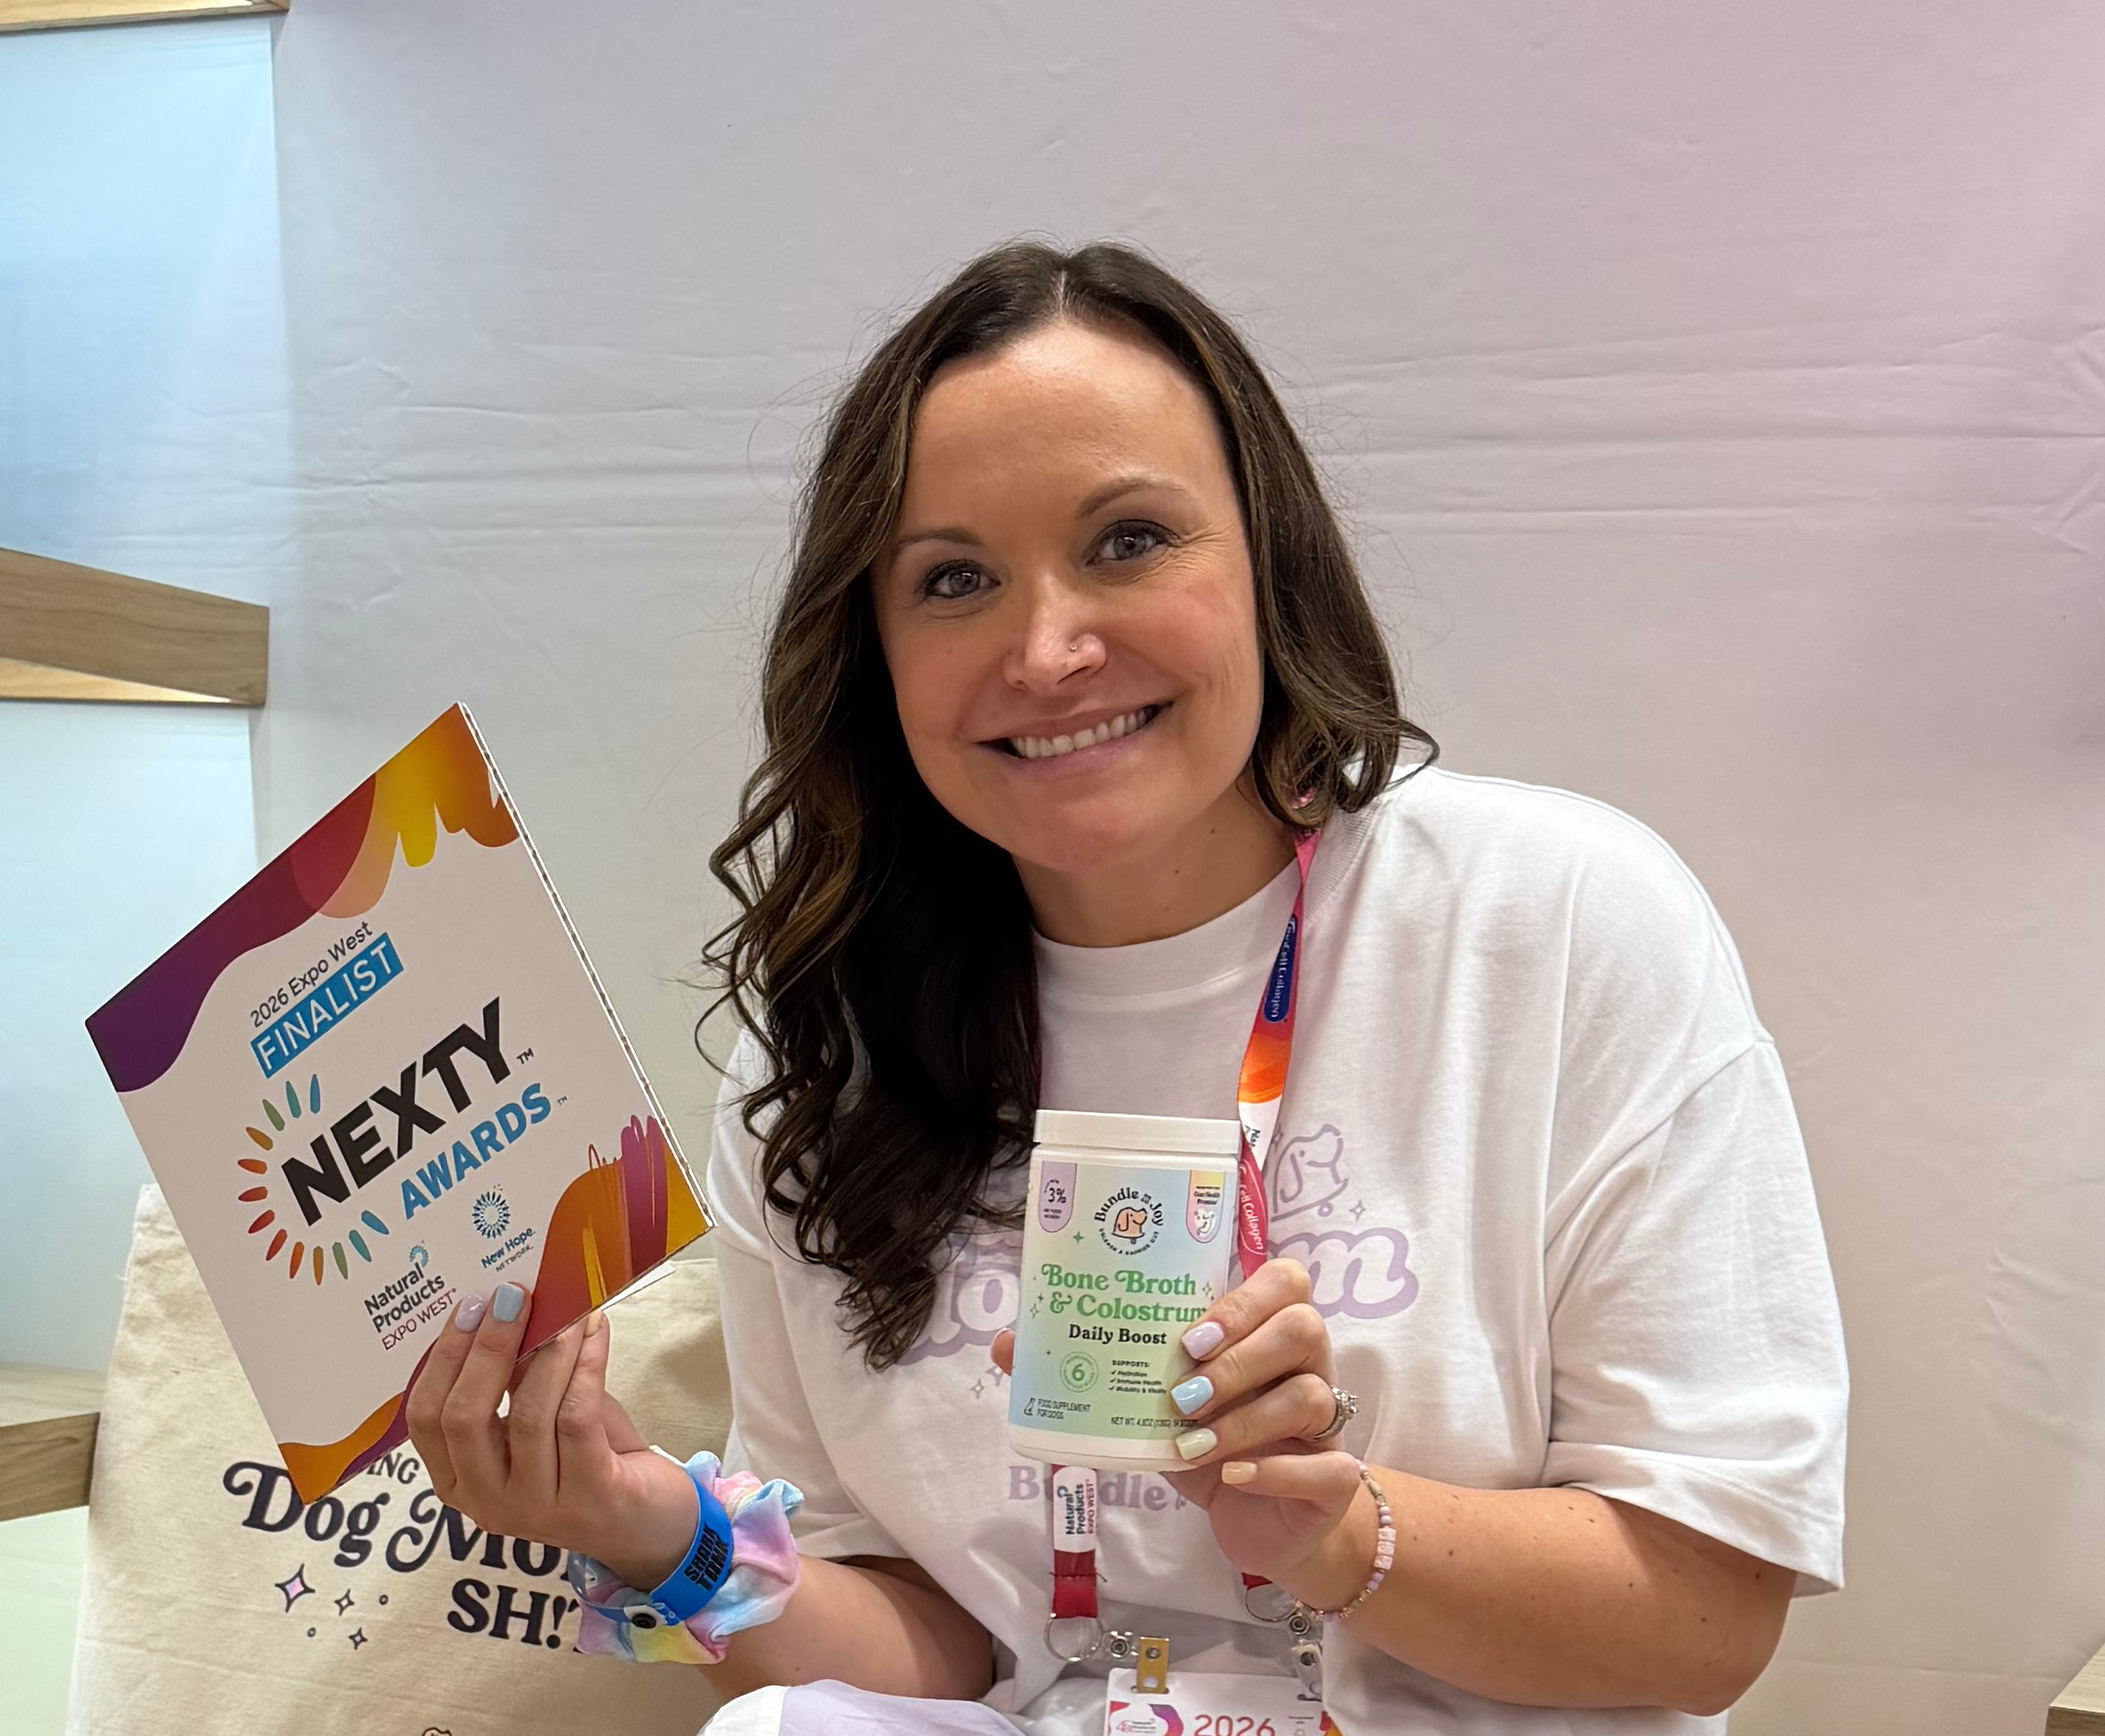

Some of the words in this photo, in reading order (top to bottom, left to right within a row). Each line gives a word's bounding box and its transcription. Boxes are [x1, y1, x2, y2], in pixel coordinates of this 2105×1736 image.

[249, 987, 289, 1029] 2026
[287, 954, 330, 1001] Expo
[326, 920, 374, 961] West
[256, 939, 398, 1071] FINALIST
[280, 995, 511, 1227] NEXTY
[399, 1082, 552, 1220] AWARDS
[1048, 1187, 1066, 1204] 3%
[1094, 1187, 1139, 1222] Bundle
[1149, 1203, 1165, 1227] Joy
[481, 1247, 505, 1269] New
[505, 1228, 533, 1251] Hope
[1244, 1203, 1265, 1250] Collagen
[363, 1261, 424, 1316] Natural
[1041, 1263, 1109, 1291] Bone
[1114, 1269, 1197, 1297] Broth
[373, 1275, 445, 1333] Products
[1049, 1291, 1073, 1314] &
[382, 1318, 417, 1351] EXPO
[1068, 1325, 1114, 1345] Daily
[1118, 1327, 1167, 1346] Boost
[1072, 1363, 1085, 1382] 6
[222, 1459, 391, 1568] Dog
[385, 1488, 570, 1577] Mo
[1063, 1493, 1075, 1535] Natural
[1075, 1483, 1086, 1535] Products
[448, 1579, 581, 1653] SH!
[1194, 1714, 1276, 1736] 2026
